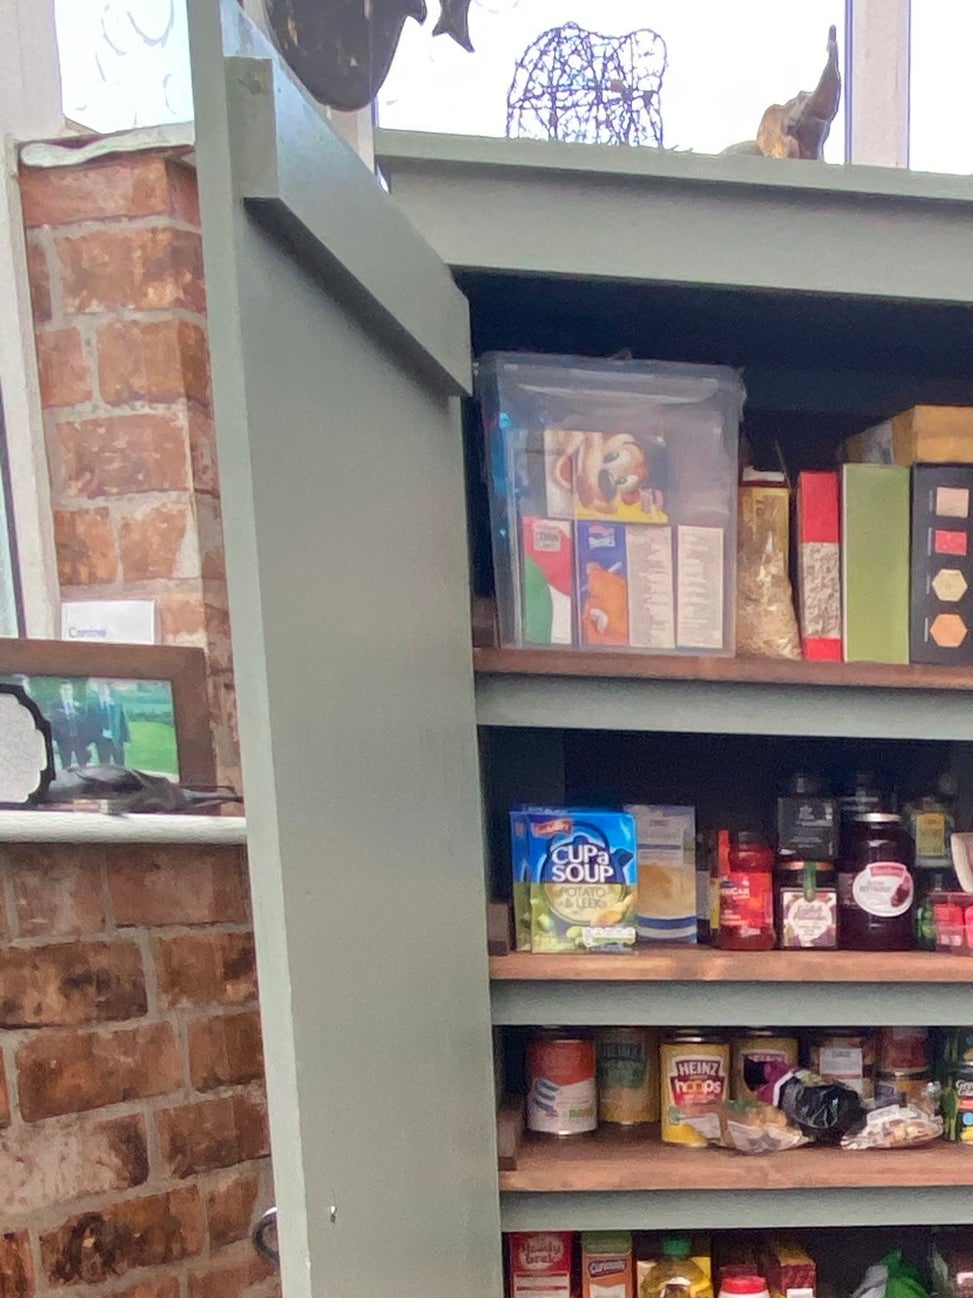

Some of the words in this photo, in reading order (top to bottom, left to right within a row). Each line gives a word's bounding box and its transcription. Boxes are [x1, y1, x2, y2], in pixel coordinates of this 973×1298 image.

[551, 863, 615, 883] SOUP
[560, 886, 607, 898] POTATO
[677, 1061, 720, 1076] HEINZ
[675, 1079, 721, 1094] hoops
